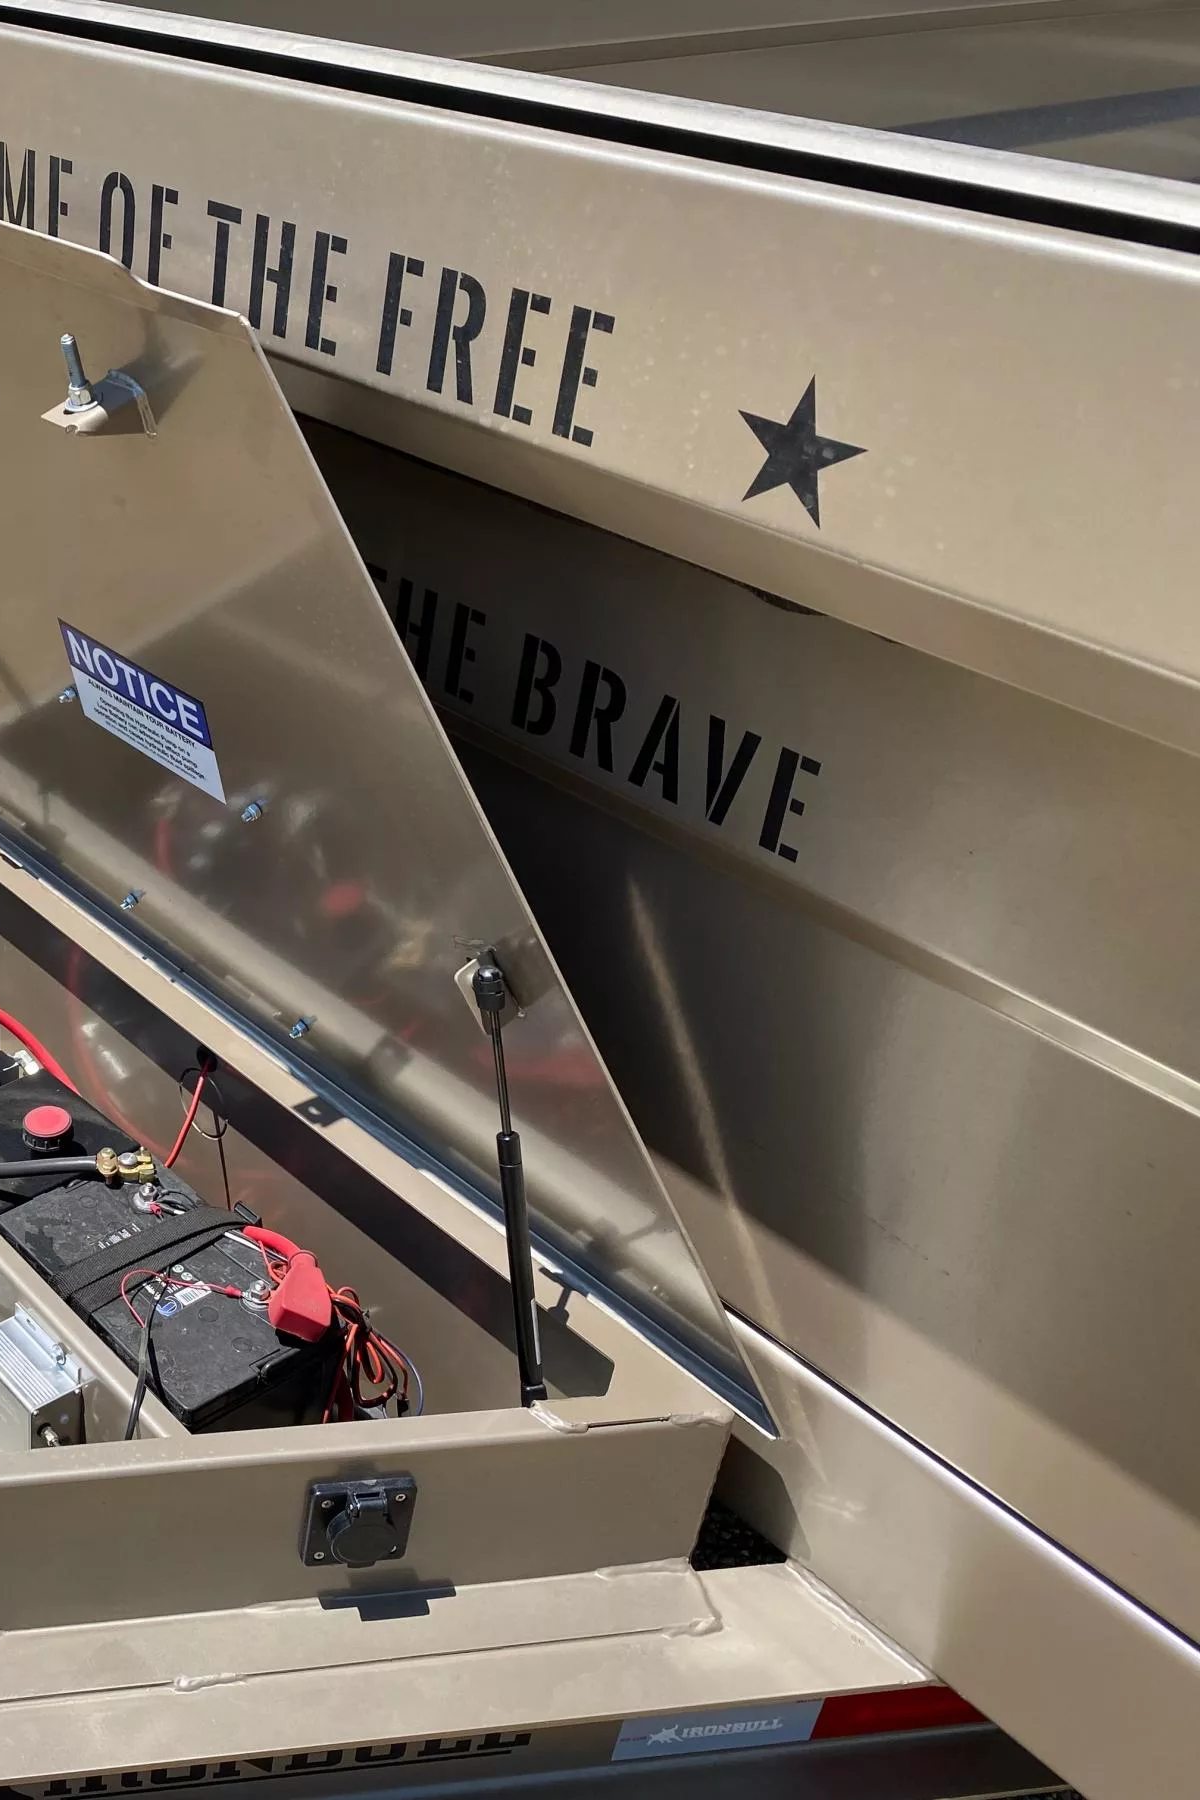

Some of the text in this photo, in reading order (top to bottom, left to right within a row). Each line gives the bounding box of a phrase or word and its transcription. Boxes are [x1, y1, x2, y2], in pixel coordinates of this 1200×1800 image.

[100, 171, 179, 286] OF
[207, 200, 348, 357] THE
[376, 253, 616, 448] FREE
[67, 630, 204, 740] NOTICE
[365, 561, 822, 864] HE BRAVE
[681, 1716, 784, 1738] IRONBULL
